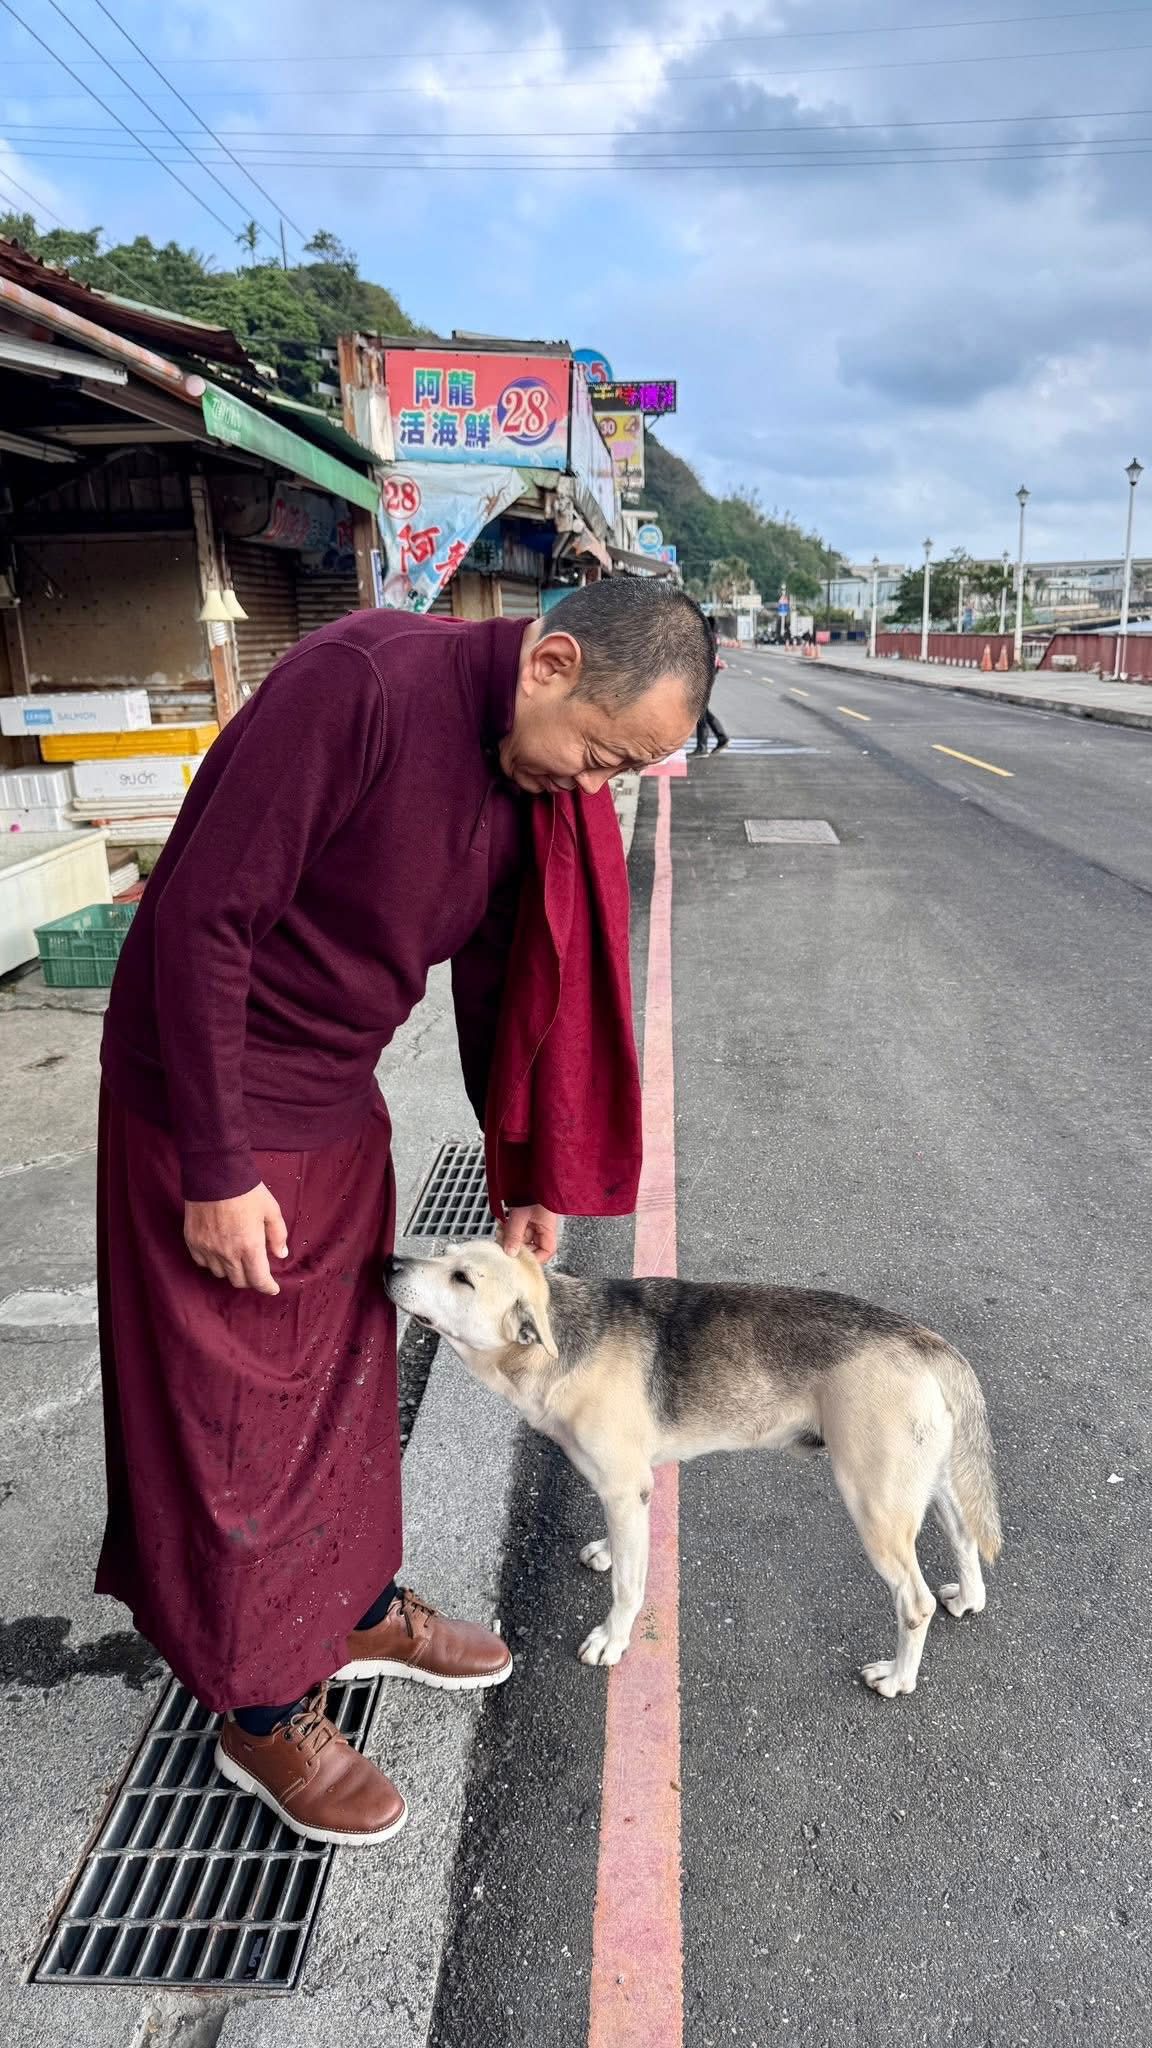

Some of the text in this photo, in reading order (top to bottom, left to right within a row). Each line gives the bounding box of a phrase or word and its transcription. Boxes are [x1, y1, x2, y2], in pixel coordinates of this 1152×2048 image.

[414, 369, 475, 407] 阿龍
[400, 411, 491, 449] 活海鮮
[502, 389, 547, 434] 28
[384, 481, 417, 512] 28
[56, 711, 97, 721] SALMON
